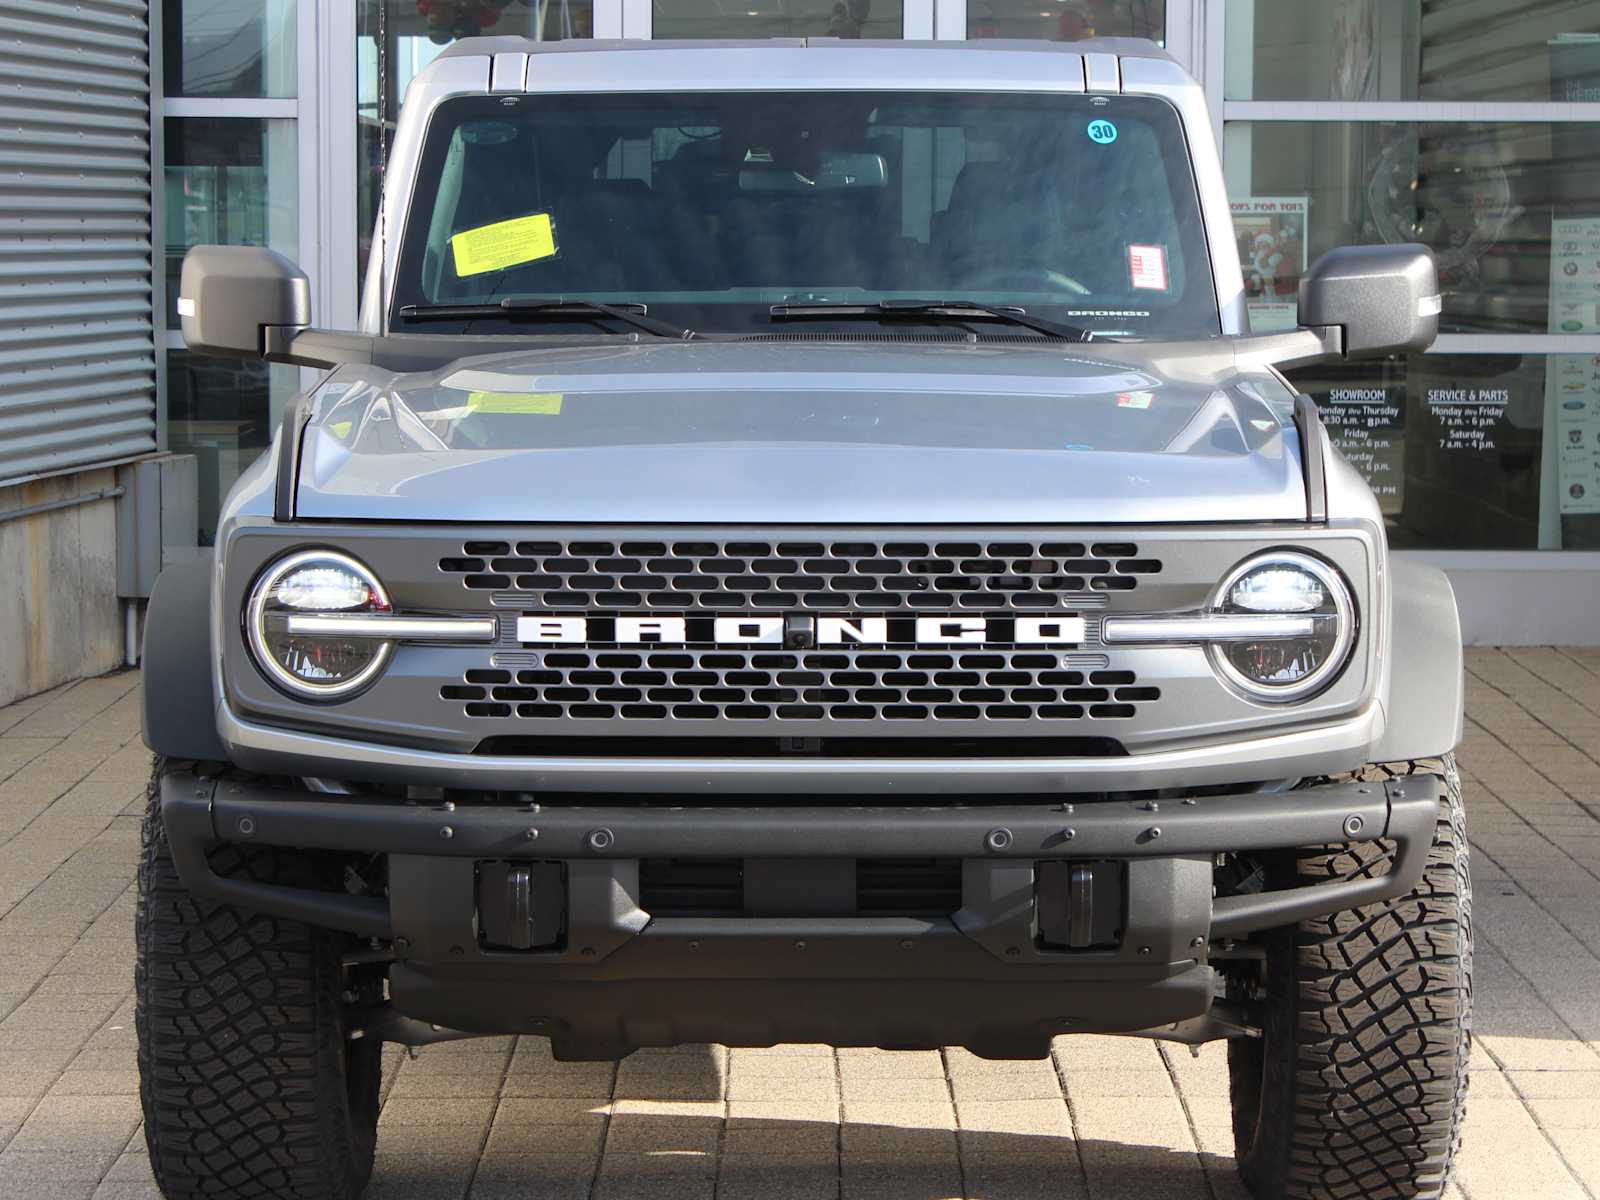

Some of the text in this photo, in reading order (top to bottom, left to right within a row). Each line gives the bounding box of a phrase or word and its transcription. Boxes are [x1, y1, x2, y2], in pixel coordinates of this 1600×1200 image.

[1091, 125, 1114, 139] 30
[1330, 390, 1386, 401] SHOWROOM
[1428, 390, 1509, 401] SERVICE & PARTS
[1362, 406, 1399, 417] Thursday
[1431, 406, 1462, 417] Monday
[1479, 406, 1504, 418] Friday
[1367, 418, 1374, 427] 8
[1374, 418, 1391, 427] p.m.
[1447, 417, 1464, 425] a.m.
[1480, 417, 1496, 427] p.m.
[1344, 429, 1369, 440] Friday
[1449, 429, 1485, 441] Saturday
[1447, 441, 1463, 449] a.m.
[1479, 441, 1496, 451] p.m.
[517, 616, 1086, 645] BRONCO
